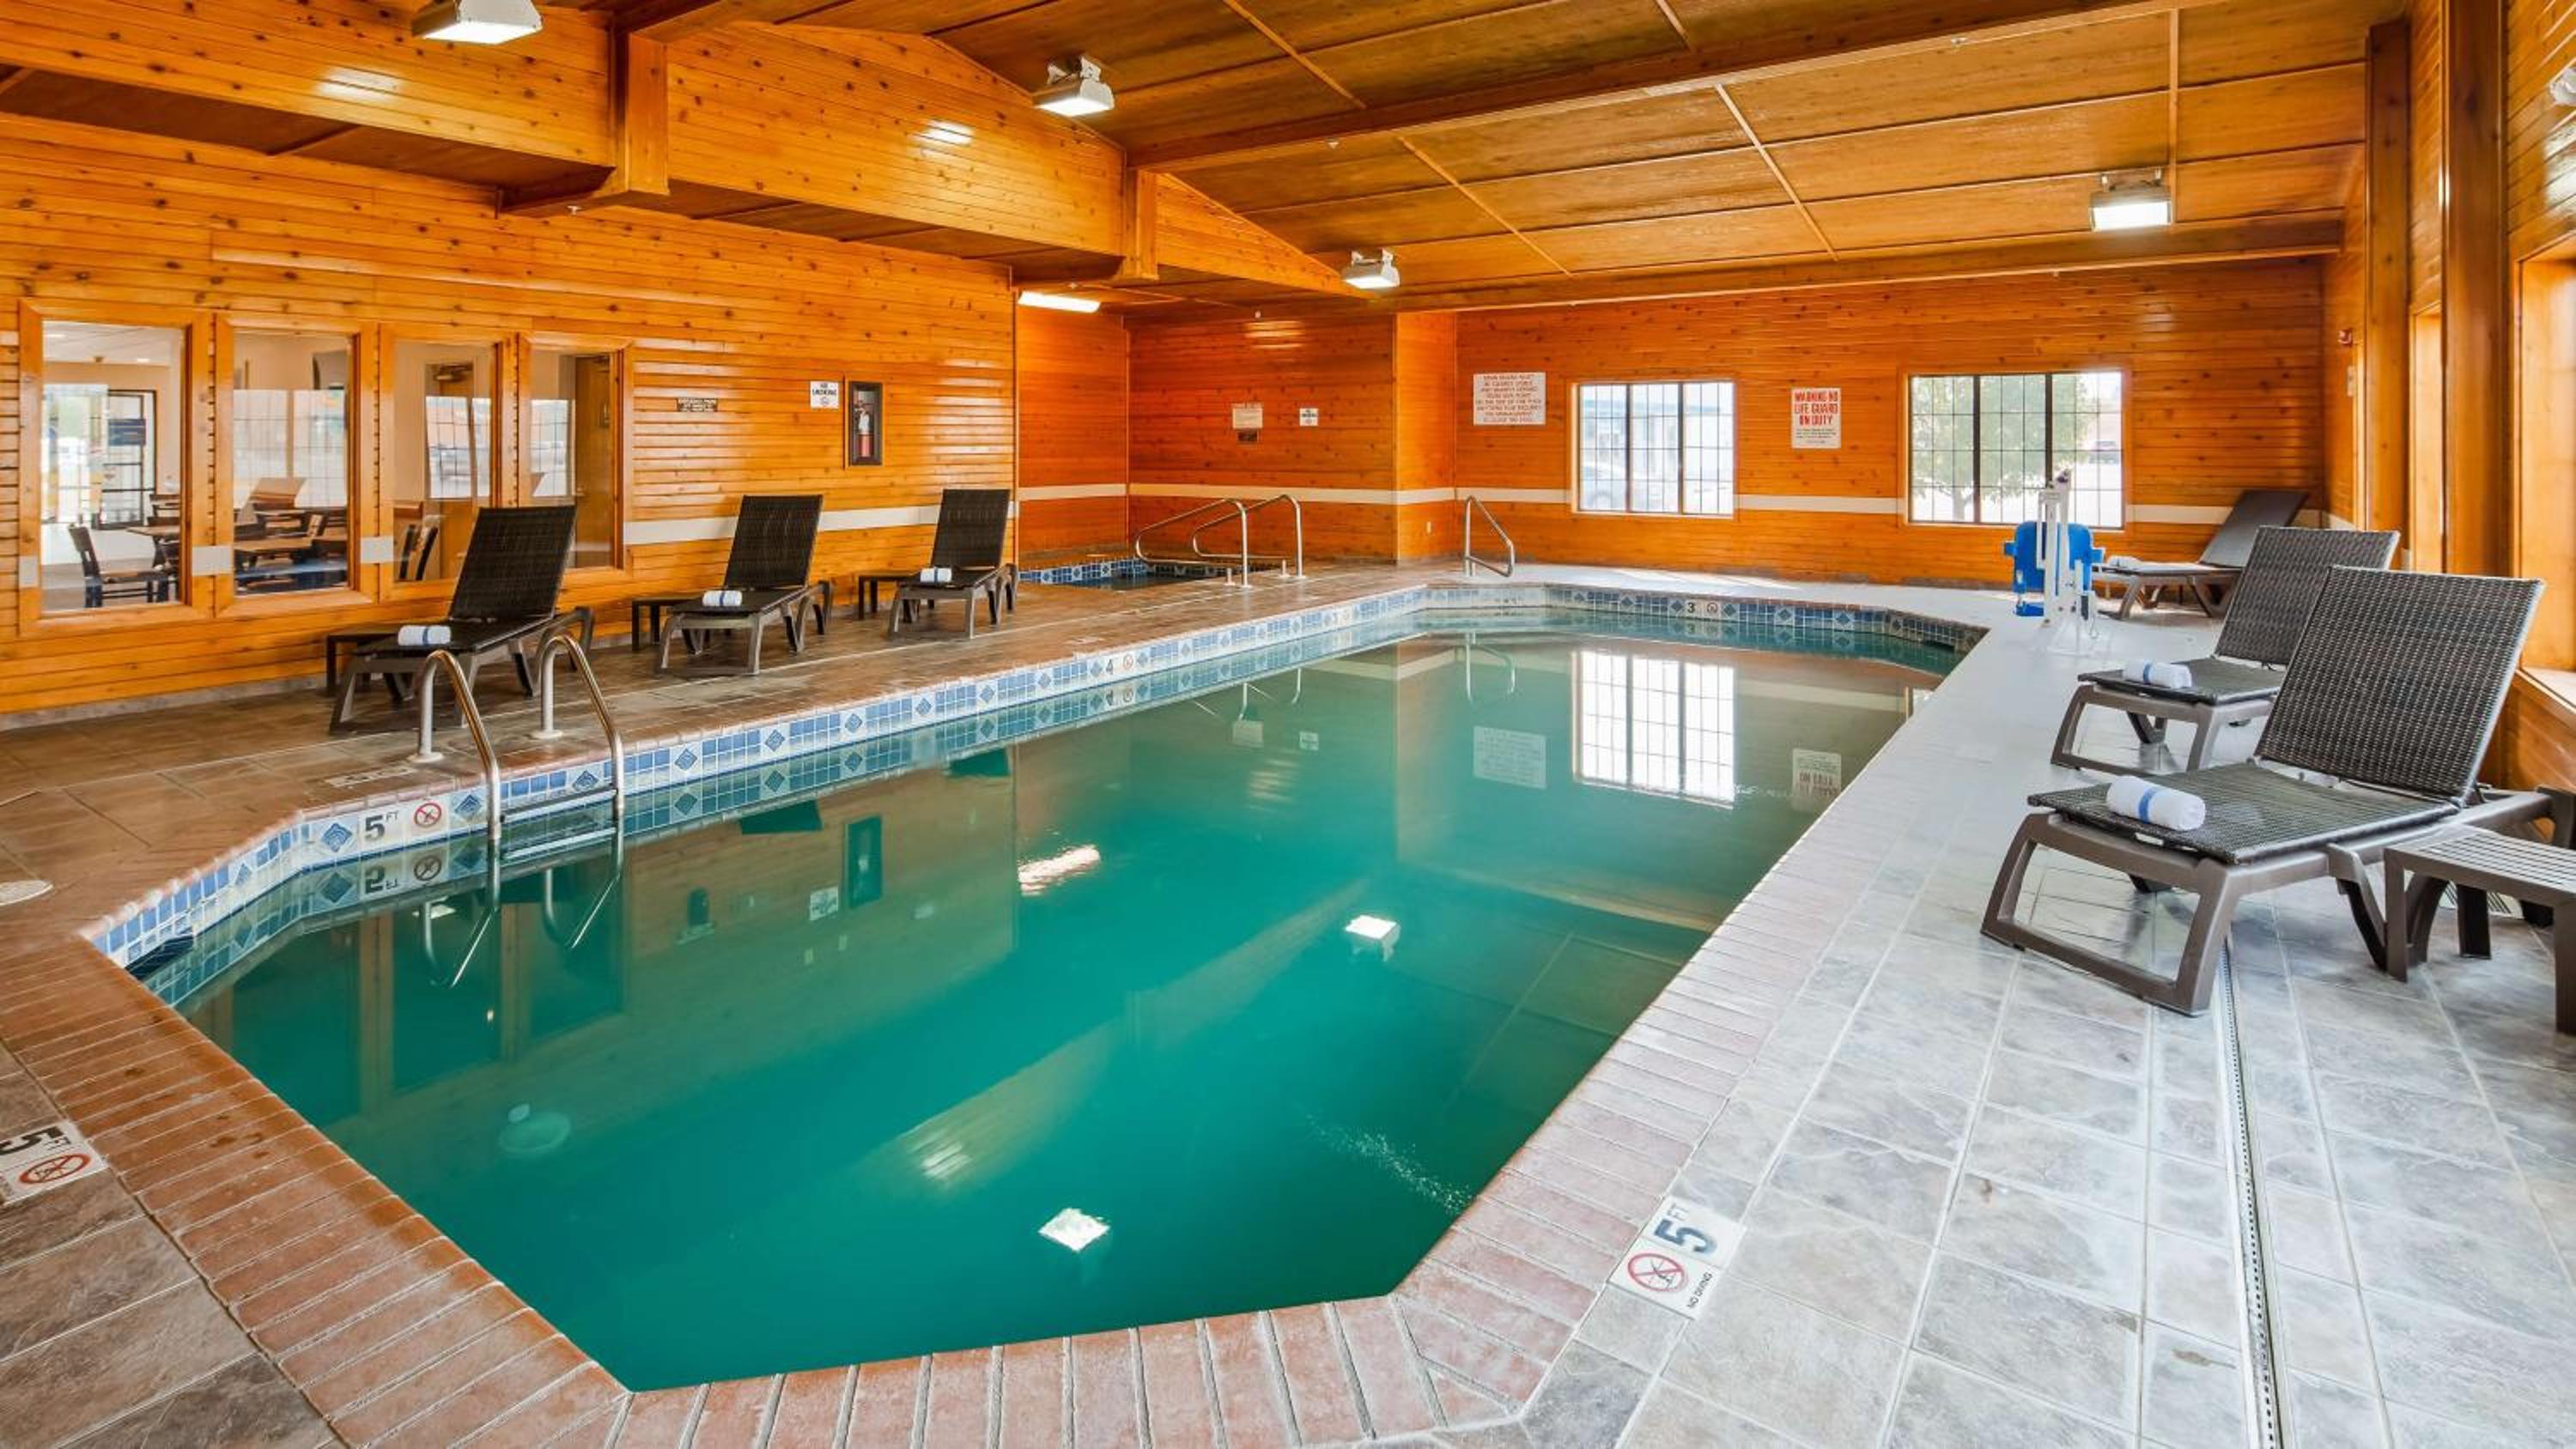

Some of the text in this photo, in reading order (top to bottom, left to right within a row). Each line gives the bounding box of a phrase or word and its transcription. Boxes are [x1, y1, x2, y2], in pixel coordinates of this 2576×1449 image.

[1795, 391, 1838, 402] WARNING NO
[1795, 403, 1838, 414] LIFE GUARD
[1800, 415, 1833, 426] ON DUTY
[1687, 602, 1695, 613] 3
[1106, 658, 1114, 676] 4
[366, 810, 398, 841] 5 FT
[1654, 1219, 1717, 1253] 5
[1686, 1272, 1713, 1308] NO DIVING
